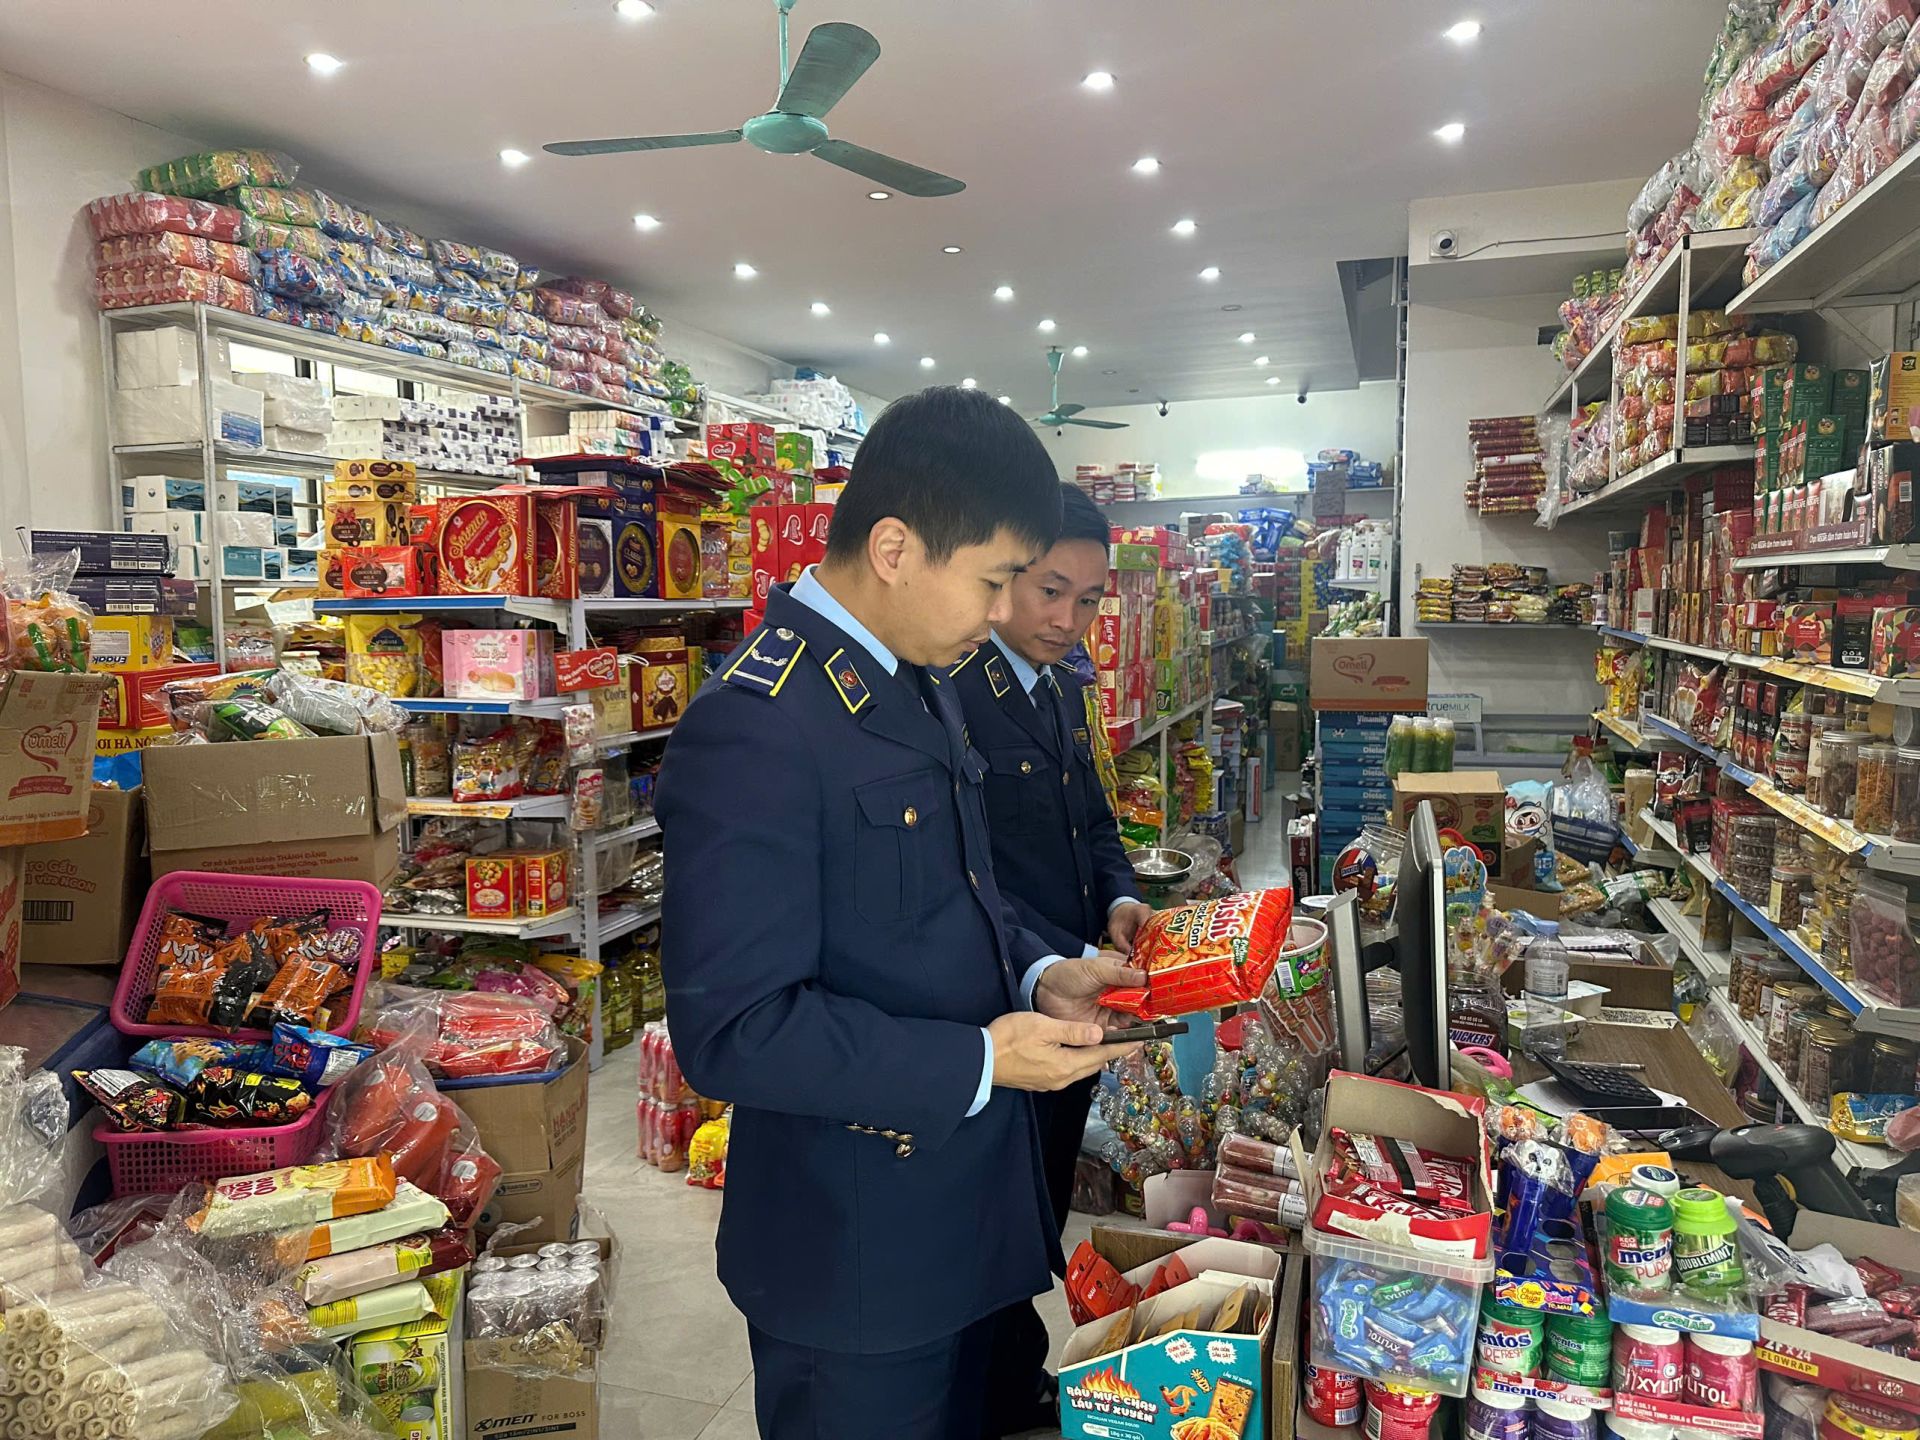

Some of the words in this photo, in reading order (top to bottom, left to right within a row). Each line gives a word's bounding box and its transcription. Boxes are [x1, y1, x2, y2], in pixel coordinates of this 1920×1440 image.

[92, 656, 126, 664] Enaak
[1338, 657, 1368, 670] Omeli
[28, 733, 66, 749] Omeli
[1677, 1244, 1731, 1271] DOUBLEMINT
[1520, 1294, 1541, 1302] Chups
[1521, 1288, 1542, 1296] Chupa
[1654, 1312, 1690, 1328] Cool
[1690, 1319, 1713, 1330] Air
[1368, 1328, 1400, 1352] XYLITOL
[1481, 1333, 1532, 1348] entos
[1550, 1333, 1584, 1350] mentos
[1761, 1351, 1812, 1372] FLOWRAP
[1092, 1387, 1120, 1404] MỰC
[1123, 1396, 1158, 1412] CHAY
[1494, 1382, 1557, 1401] mentos
[1558, 1393, 1585, 1406] PURE
[542, 1414, 560, 1422] FOR
[563, 1410, 586, 1418] BOSS
[1108, 1418, 1124, 1426] VEGAN
[1112, 1405, 1154, 1423] XUYÊN
